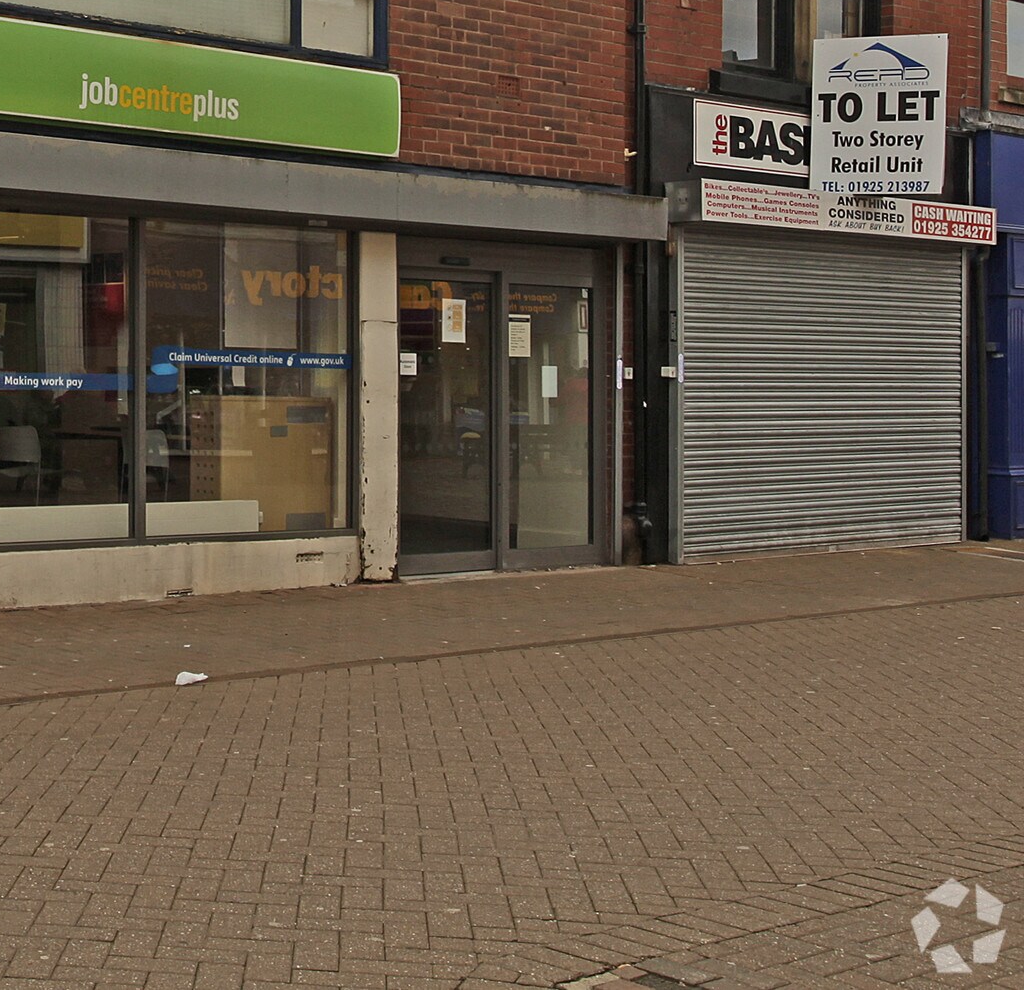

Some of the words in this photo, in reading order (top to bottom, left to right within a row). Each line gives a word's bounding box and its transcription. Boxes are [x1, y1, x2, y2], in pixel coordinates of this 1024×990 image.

[79, 73, 239, 122] jobcentreplus
[818, 92, 863, 123] TO
[877, 90, 940, 122] LET
[712, 114, 728, 155] the
[832, 131, 864, 147] Two
[869, 130, 924, 150] Storey
[831, 156, 880, 173] Retail
[886, 156, 923, 173] Unit
[822, 181, 844, 192] TEL:
[848, 181, 883, 192] 01925
[887, 181, 930, 192] 213987
[706, 192, 730, 200] Mobile
[788, 200, 819, 209] Consoles
[837, 196, 897, 210] ANYTHING
[779, 208, 818, 216] Instruments
[828, 208, 905, 224] CONSIDERED
[914, 205, 944, 219] CASH
[945, 208, 992, 225] WAITING
[784, 217, 819, 226] Equipment
[828, 220, 843, 228] ASK
[845, 222, 866, 230] ABOUT
[869, 223, 882, 231] BUY
[885, 225, 905, 233] BACK!
[913, 220, 949, 236] 01925
[951, 223, 992, 240] 354277
[168, 352, 192, 362] Claim
[194, 353, 232, 363] Universal
[234, 354, 258, 363] Credit
[259, 355, 283, 364] online
[300, 356, 344, 366] www.gov.uk
[4, 376, 38, 388] Making
[40, 377, 64, 386] work
[66, 379, 83, 389] pay
